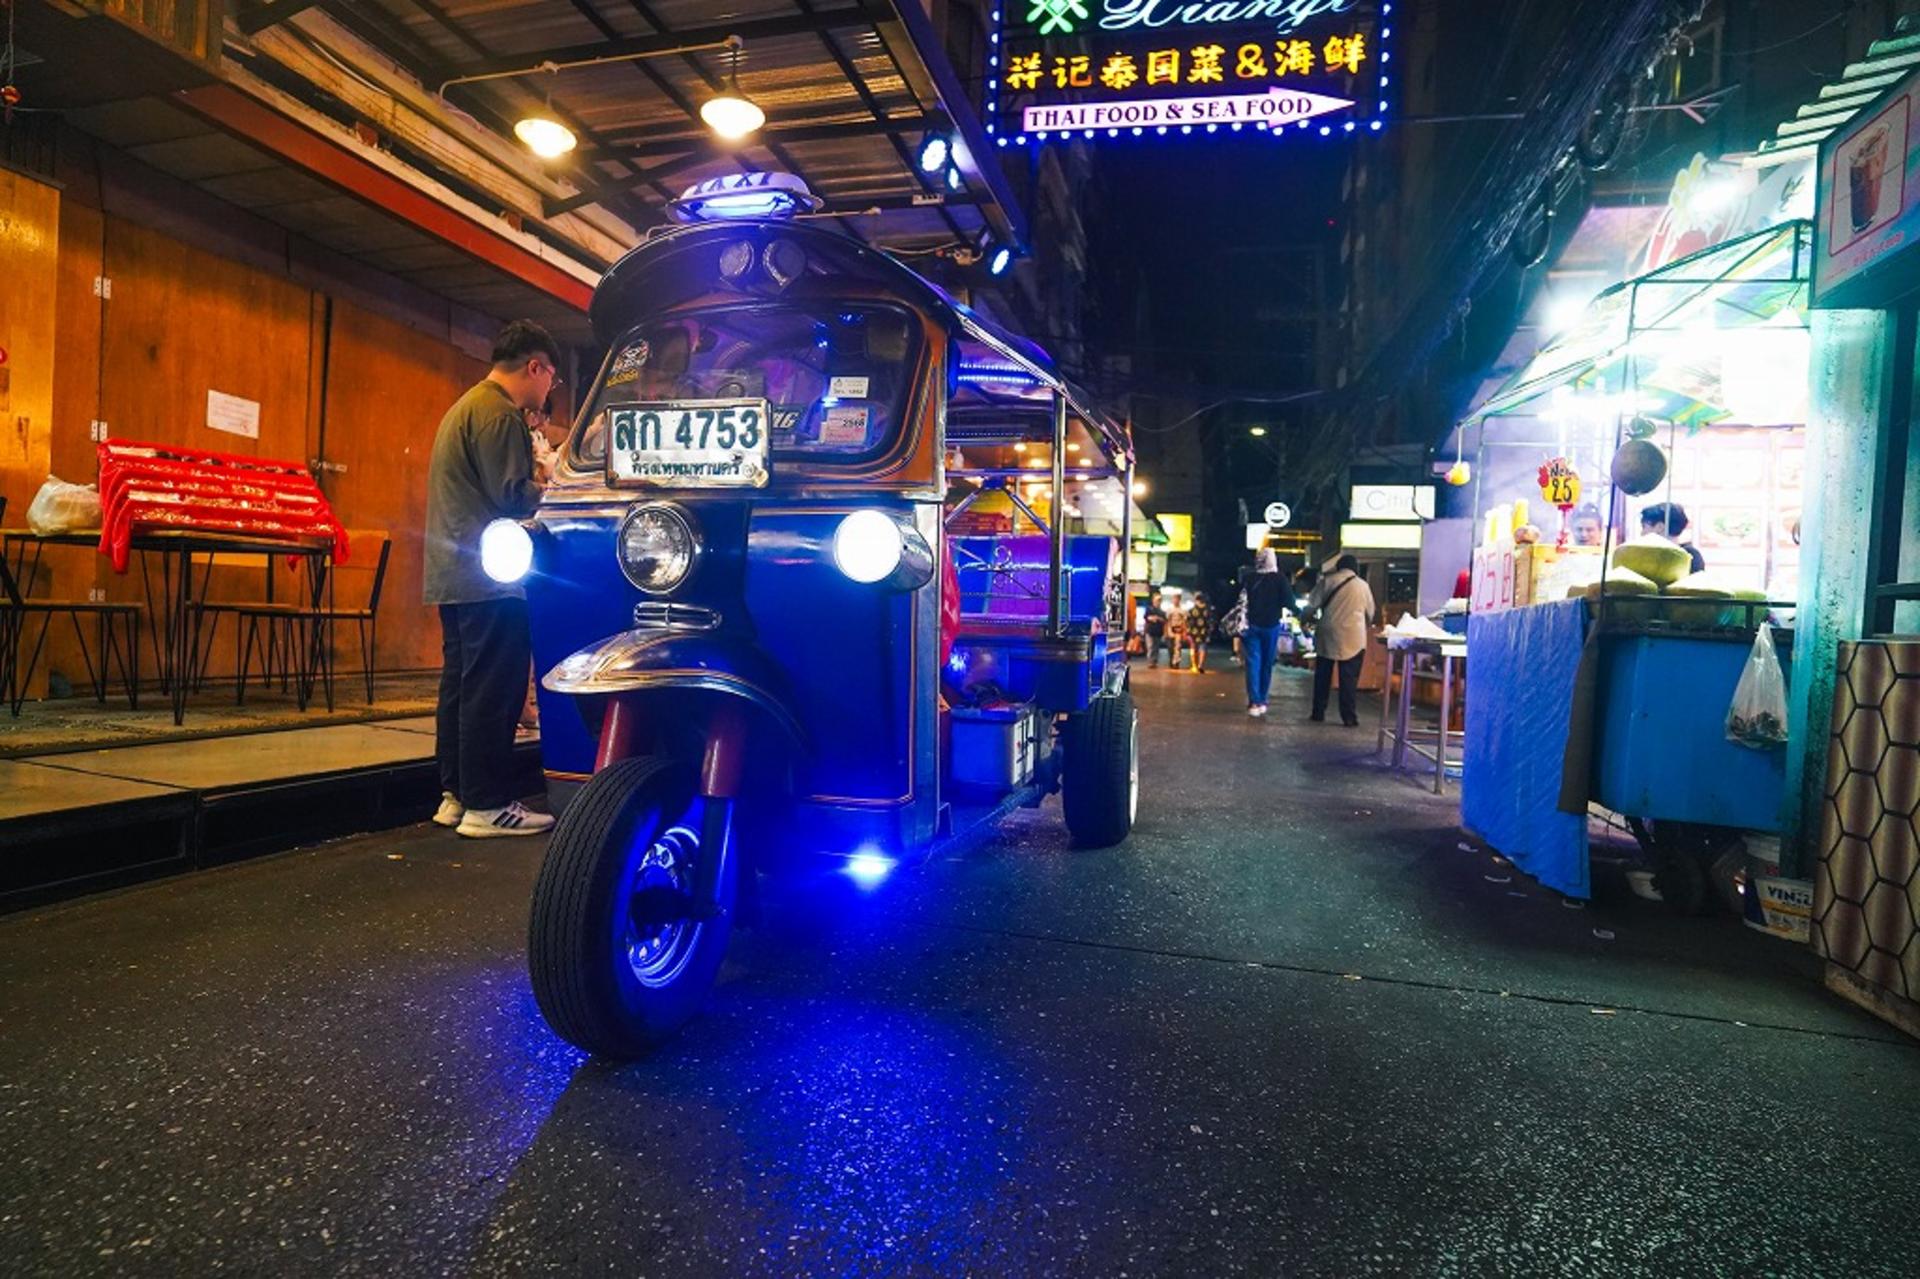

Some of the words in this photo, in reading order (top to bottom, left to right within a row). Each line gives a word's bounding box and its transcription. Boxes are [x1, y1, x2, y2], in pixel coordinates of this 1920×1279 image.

[1029, 108, 1086, 127] THAI
[1095, 104, 1158, 123] FOOD
[1165, 102, 1184, 120] &
[1191, 100, 1237, 119] SEA
[1246, 97, 1312, 116] FOOD
[675, 409, 760, 450] 4753
